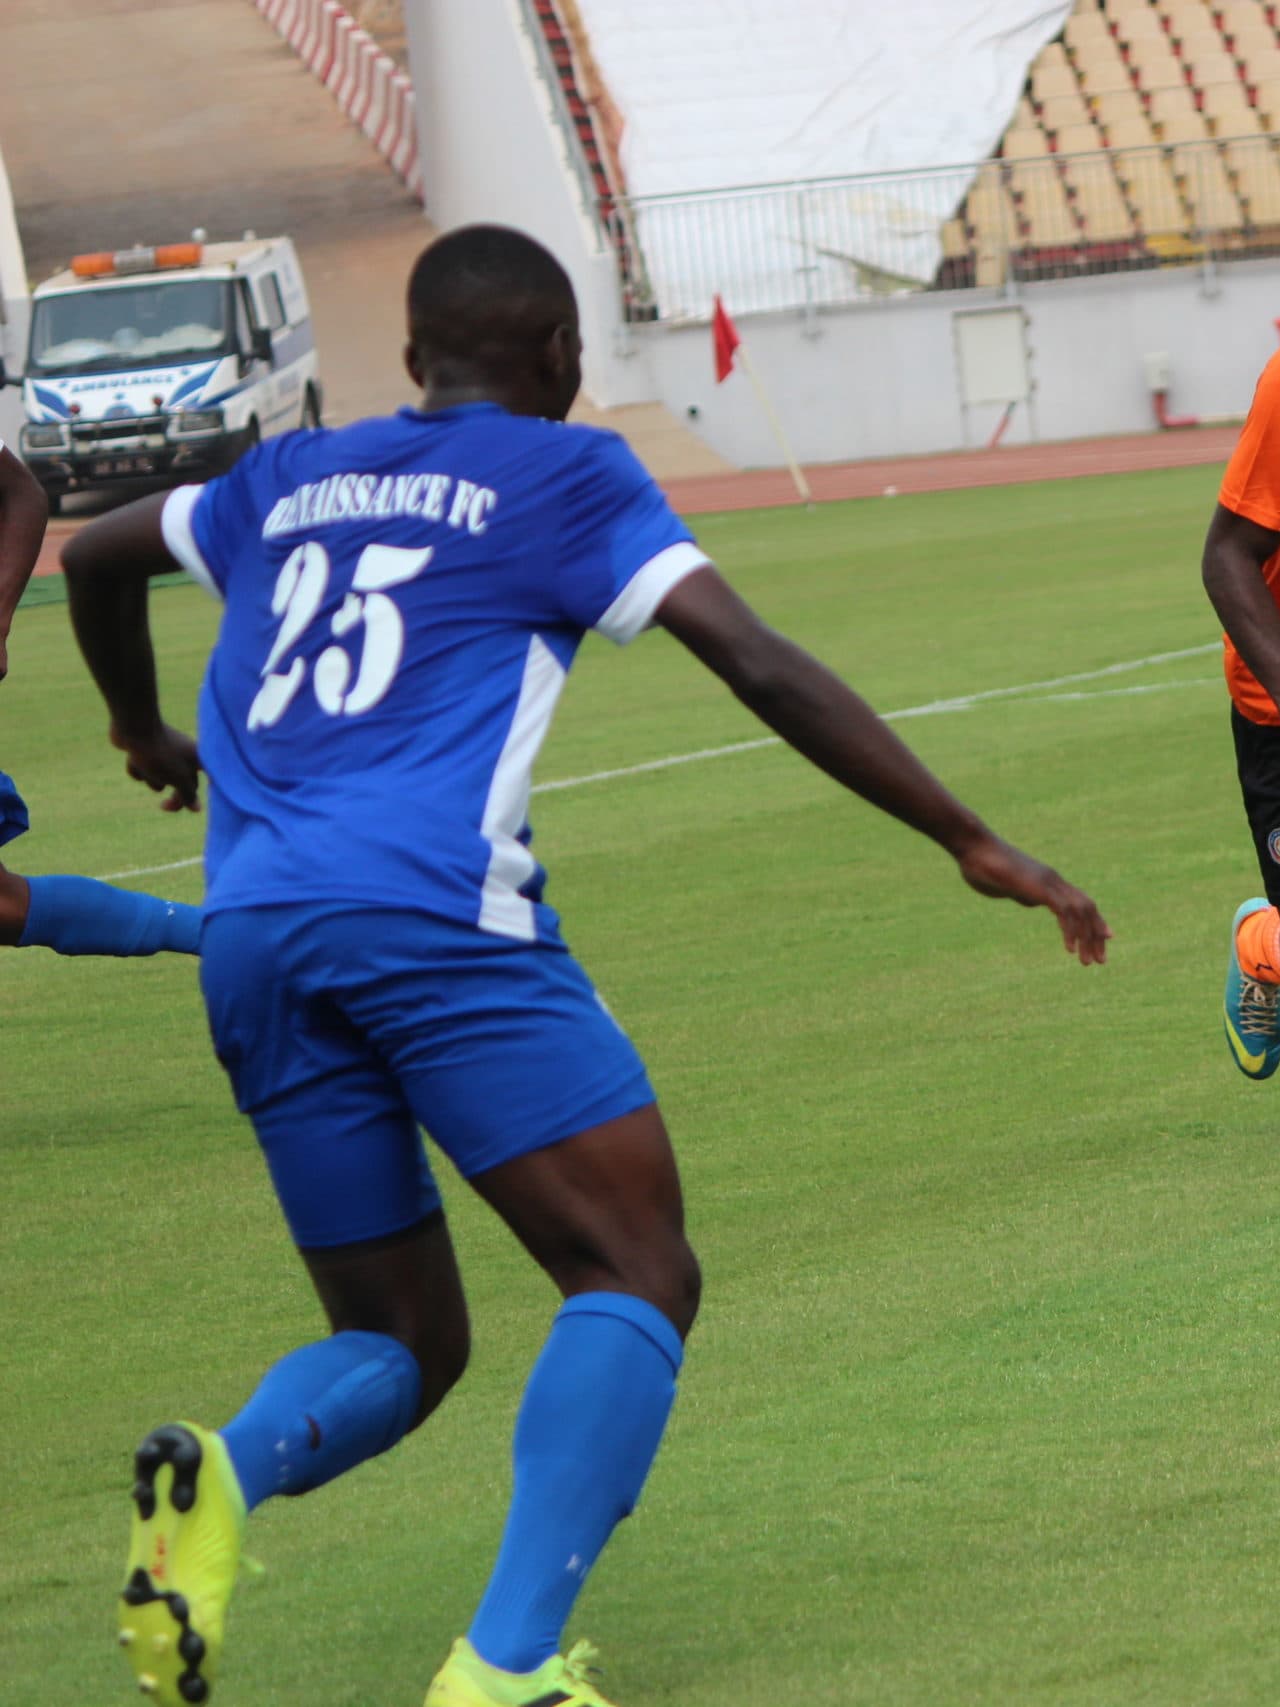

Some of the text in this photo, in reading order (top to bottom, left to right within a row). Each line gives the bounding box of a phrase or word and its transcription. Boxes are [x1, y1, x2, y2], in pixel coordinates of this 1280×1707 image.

[71, 374, 175, 393] AMBULANCE
[447, 478, 498, 536] FC
[246, 541, 434, 733] 25
